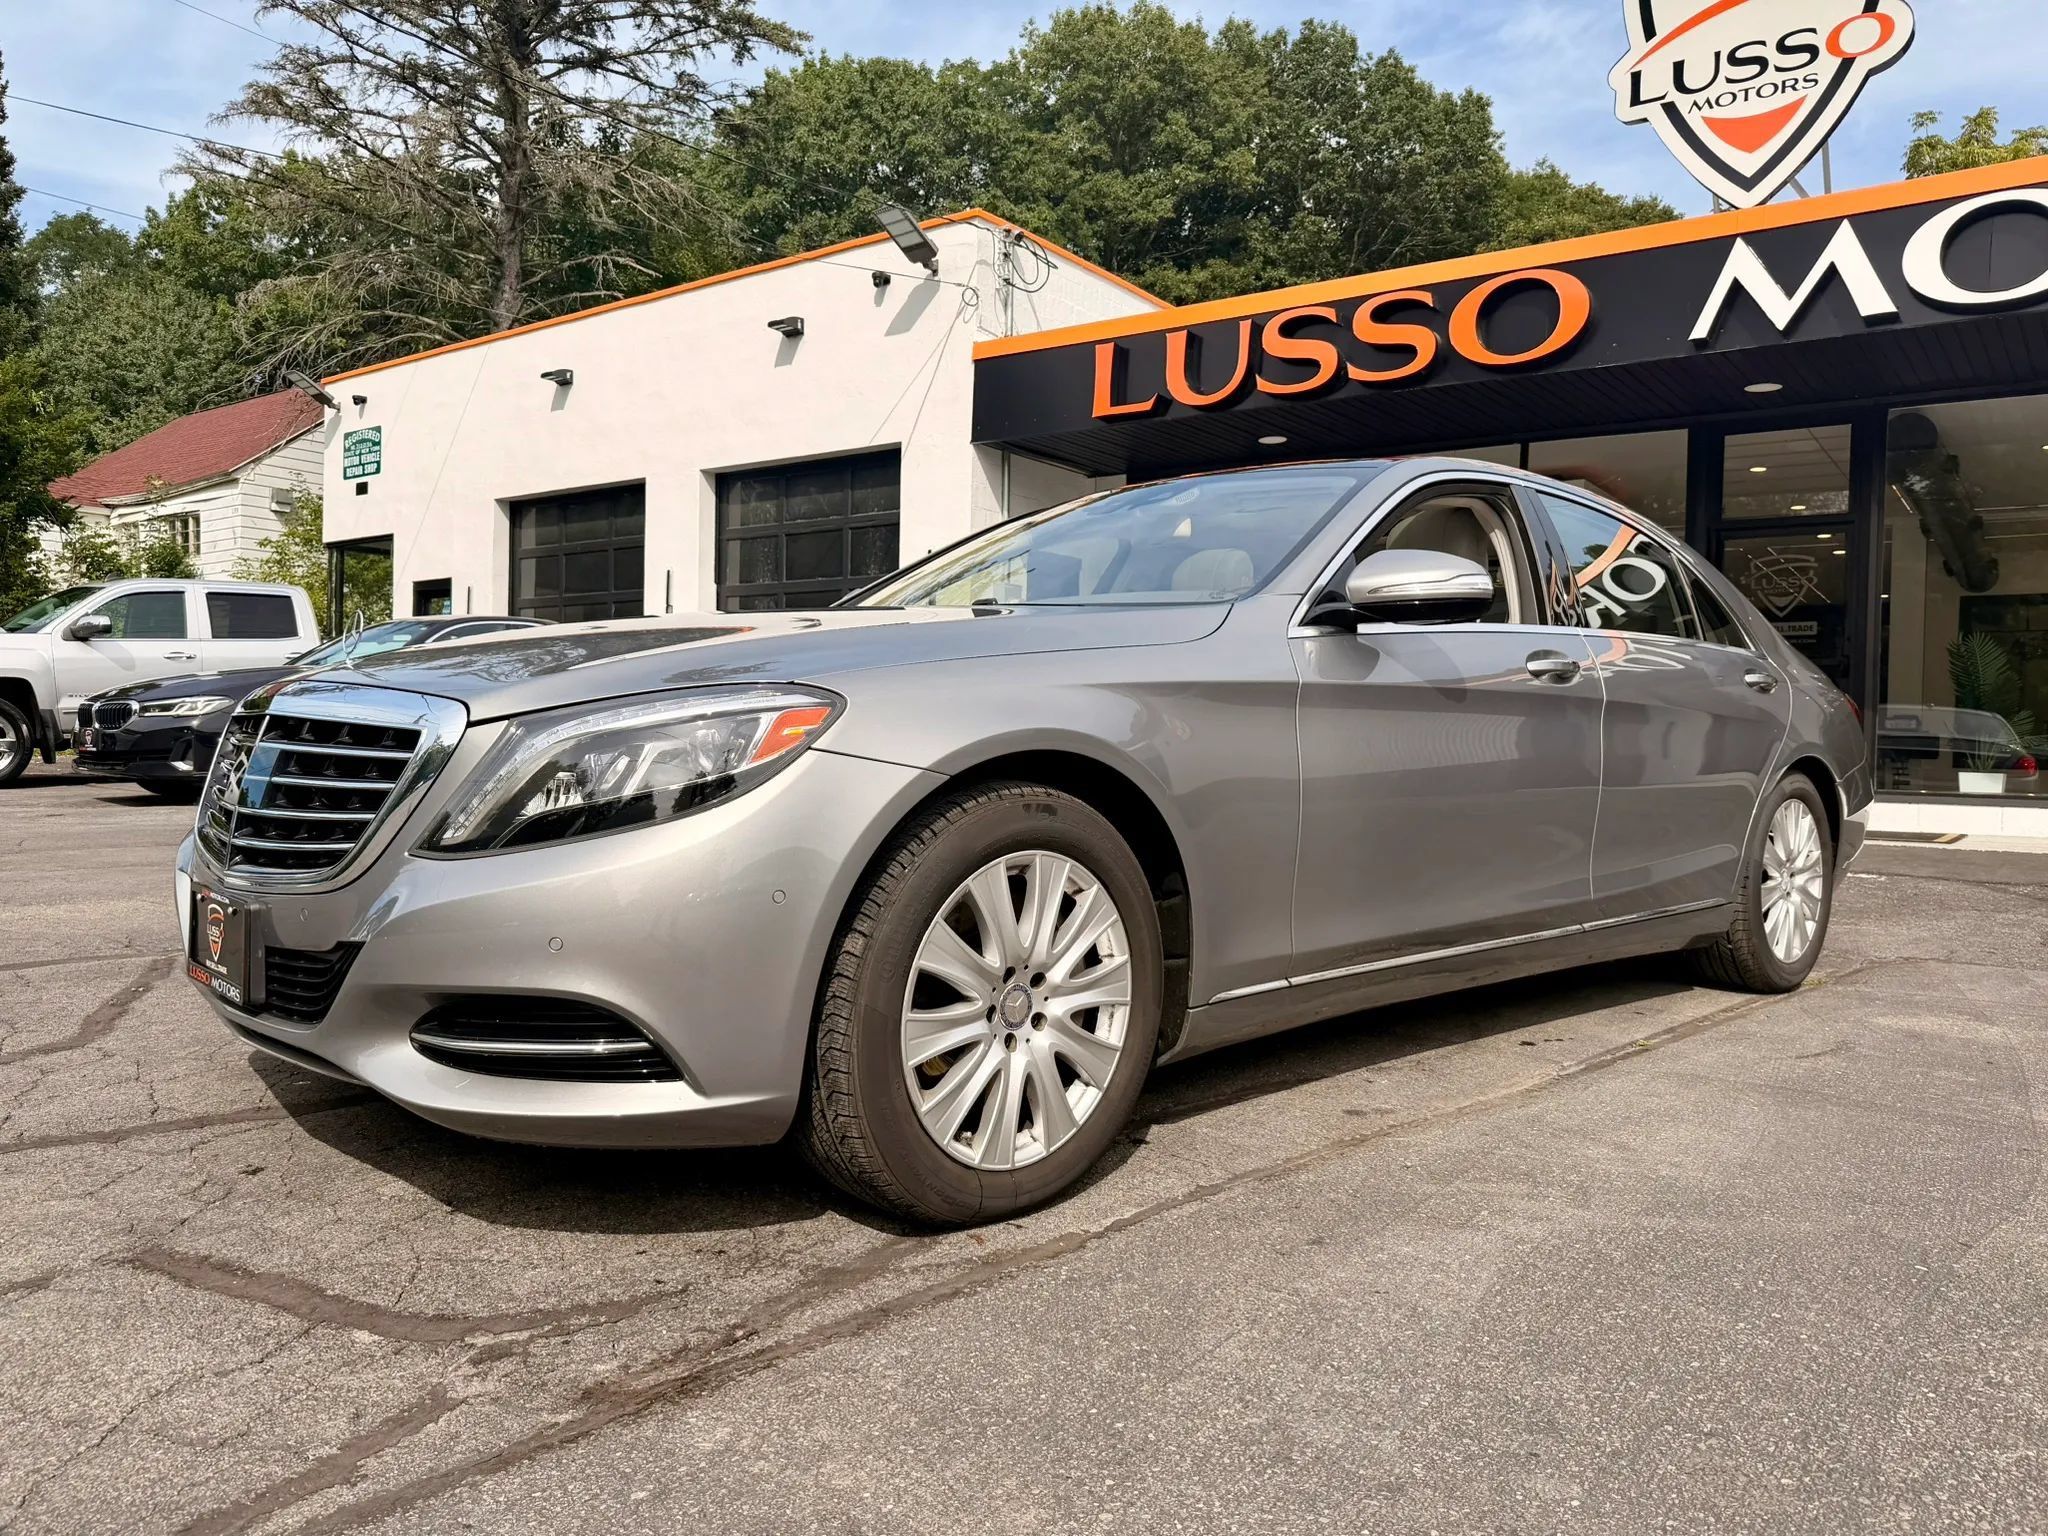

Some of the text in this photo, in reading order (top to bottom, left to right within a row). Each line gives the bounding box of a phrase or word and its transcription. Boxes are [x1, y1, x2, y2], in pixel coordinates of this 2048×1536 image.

[1630, 12, 1895, 108] LUSSO
[1688, 73, 1818, 114] MOTORS
[1092, 269, 1591, 417] LUSSO
[344, 429, 380, 449] REGISTERED
[346, 465, 363, 477] REPAIR
[190, 965, 209, 985] LUSSO
[211, 977, 241, 1002] MOTORS
